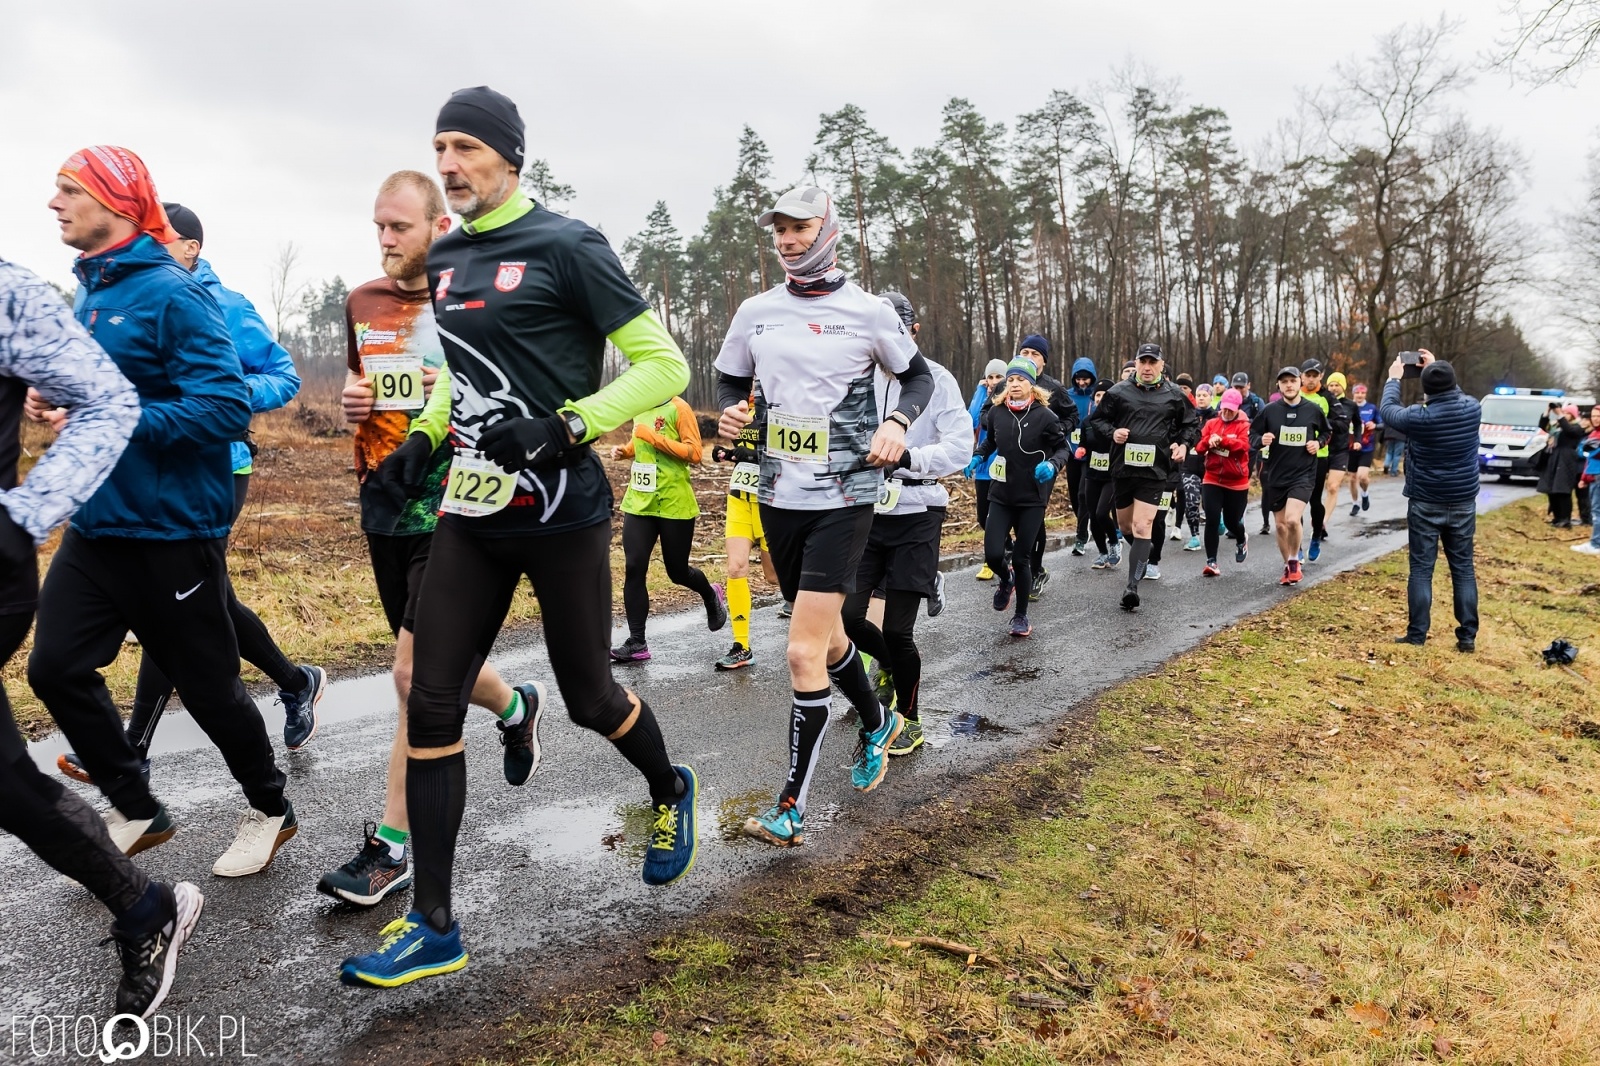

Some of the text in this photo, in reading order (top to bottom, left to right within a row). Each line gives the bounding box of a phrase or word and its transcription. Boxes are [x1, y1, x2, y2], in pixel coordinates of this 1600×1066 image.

[823, 329, 858, 337] MARATHON
[372, 373, 413, 398] 190
[777, 428, 819, 453] 194
[1284, 433, 1303, 442] 189
[1093, 458, 1108, 468] 182
[1129, 451, 1151, 462] 167
[633, 471, 651, 486] 155
[734, 471, 760, 488] 232
[453, 470, 502, 505] 222
